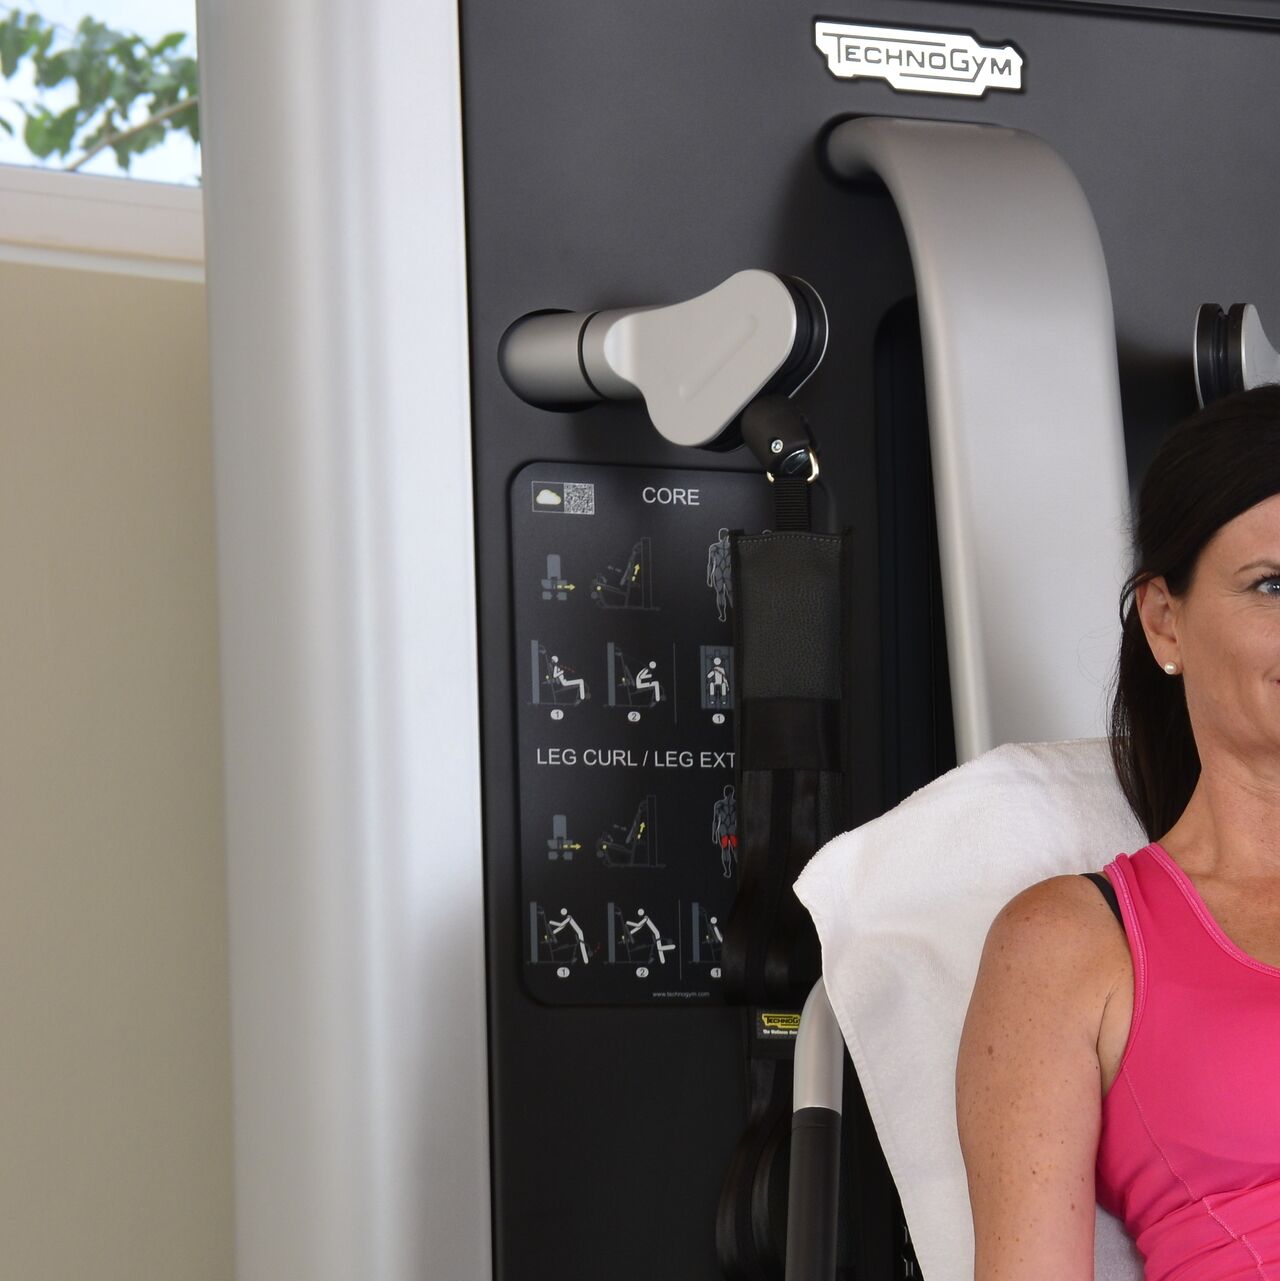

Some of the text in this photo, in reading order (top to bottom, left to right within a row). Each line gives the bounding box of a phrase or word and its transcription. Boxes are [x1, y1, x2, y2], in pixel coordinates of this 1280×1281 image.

[642, 486, 700, 506] CORE
[536, 747, 577, 765] LEG
[583, 749, 638, 767] CURL
[642, 750, 649, 767] /
[654, 750, 694, 768] LEG
